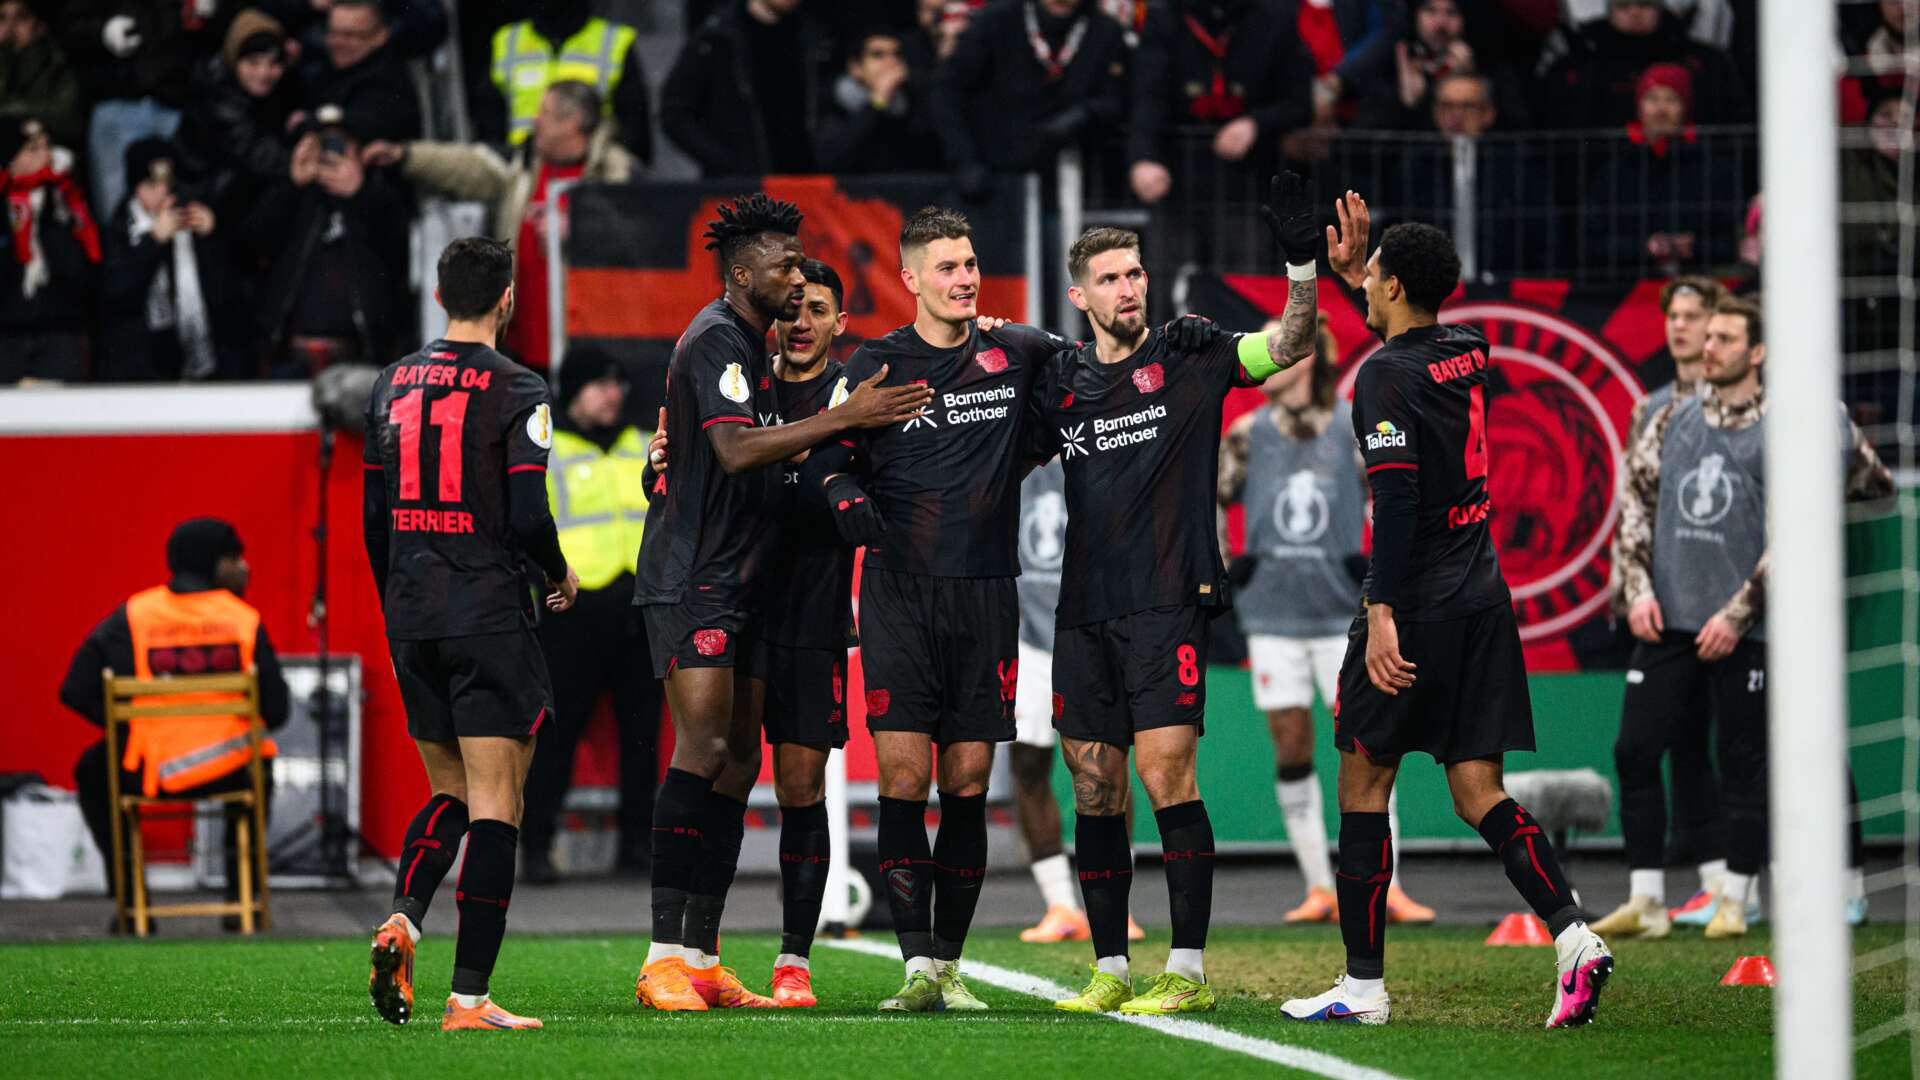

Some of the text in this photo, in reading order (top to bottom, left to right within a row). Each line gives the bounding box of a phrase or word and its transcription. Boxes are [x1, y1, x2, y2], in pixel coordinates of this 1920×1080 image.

[391, 364, 493, 391] BAYER 04
[1428, 352, 1475, 384] BAYER
[943, 384, 1016, 408] Barmenia
[946, 404, 1009, 425] Gothaer
[1093, 404, 1167, 435] Barmenia
[389, 388, 471, 503] 11
[1096, 424, 1159, 452] Gothaer
[1365, 430, 1406, 450] Talcid
[392, 508, 475, 533] TERRIER
[1177, 644, 1199, 687] 8
